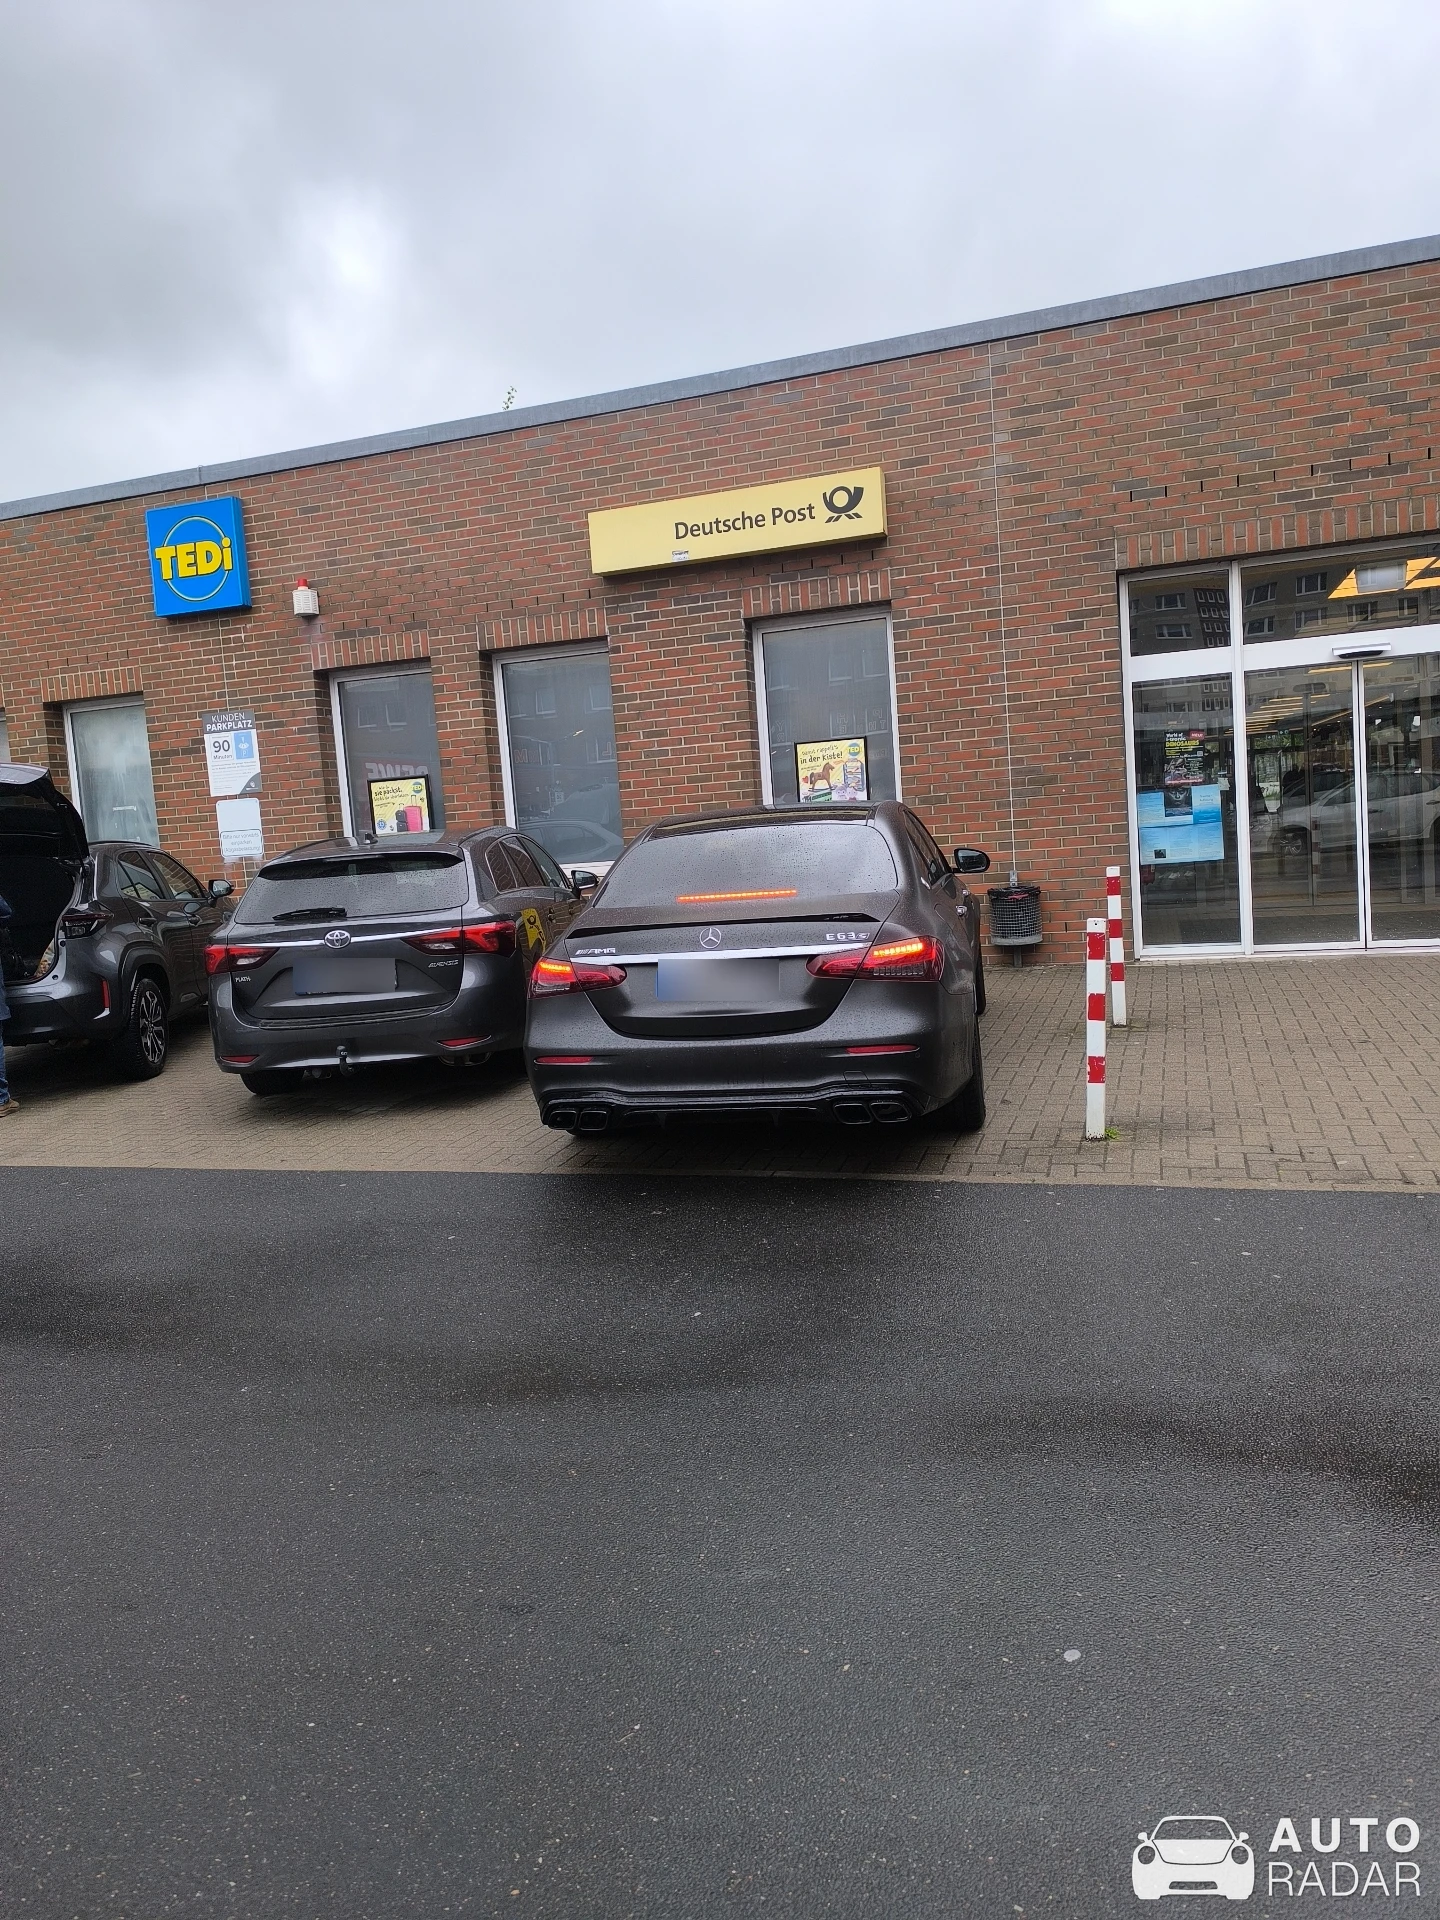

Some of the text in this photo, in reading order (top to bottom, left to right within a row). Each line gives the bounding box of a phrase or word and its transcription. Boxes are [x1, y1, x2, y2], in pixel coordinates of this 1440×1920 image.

[674, 503, 816, 540] Deutsche Post
[155, 536, 233, 580] TEDi
[211, 712, 245, 723] KUNDEN
[206, 720, 253, 732] PARKPLATZ
[212, 739, 231, 753] 90
[800, 757, 807, 765] in
[808, 755, 821, 763] der
[585, 947, 616, 955] AMG
